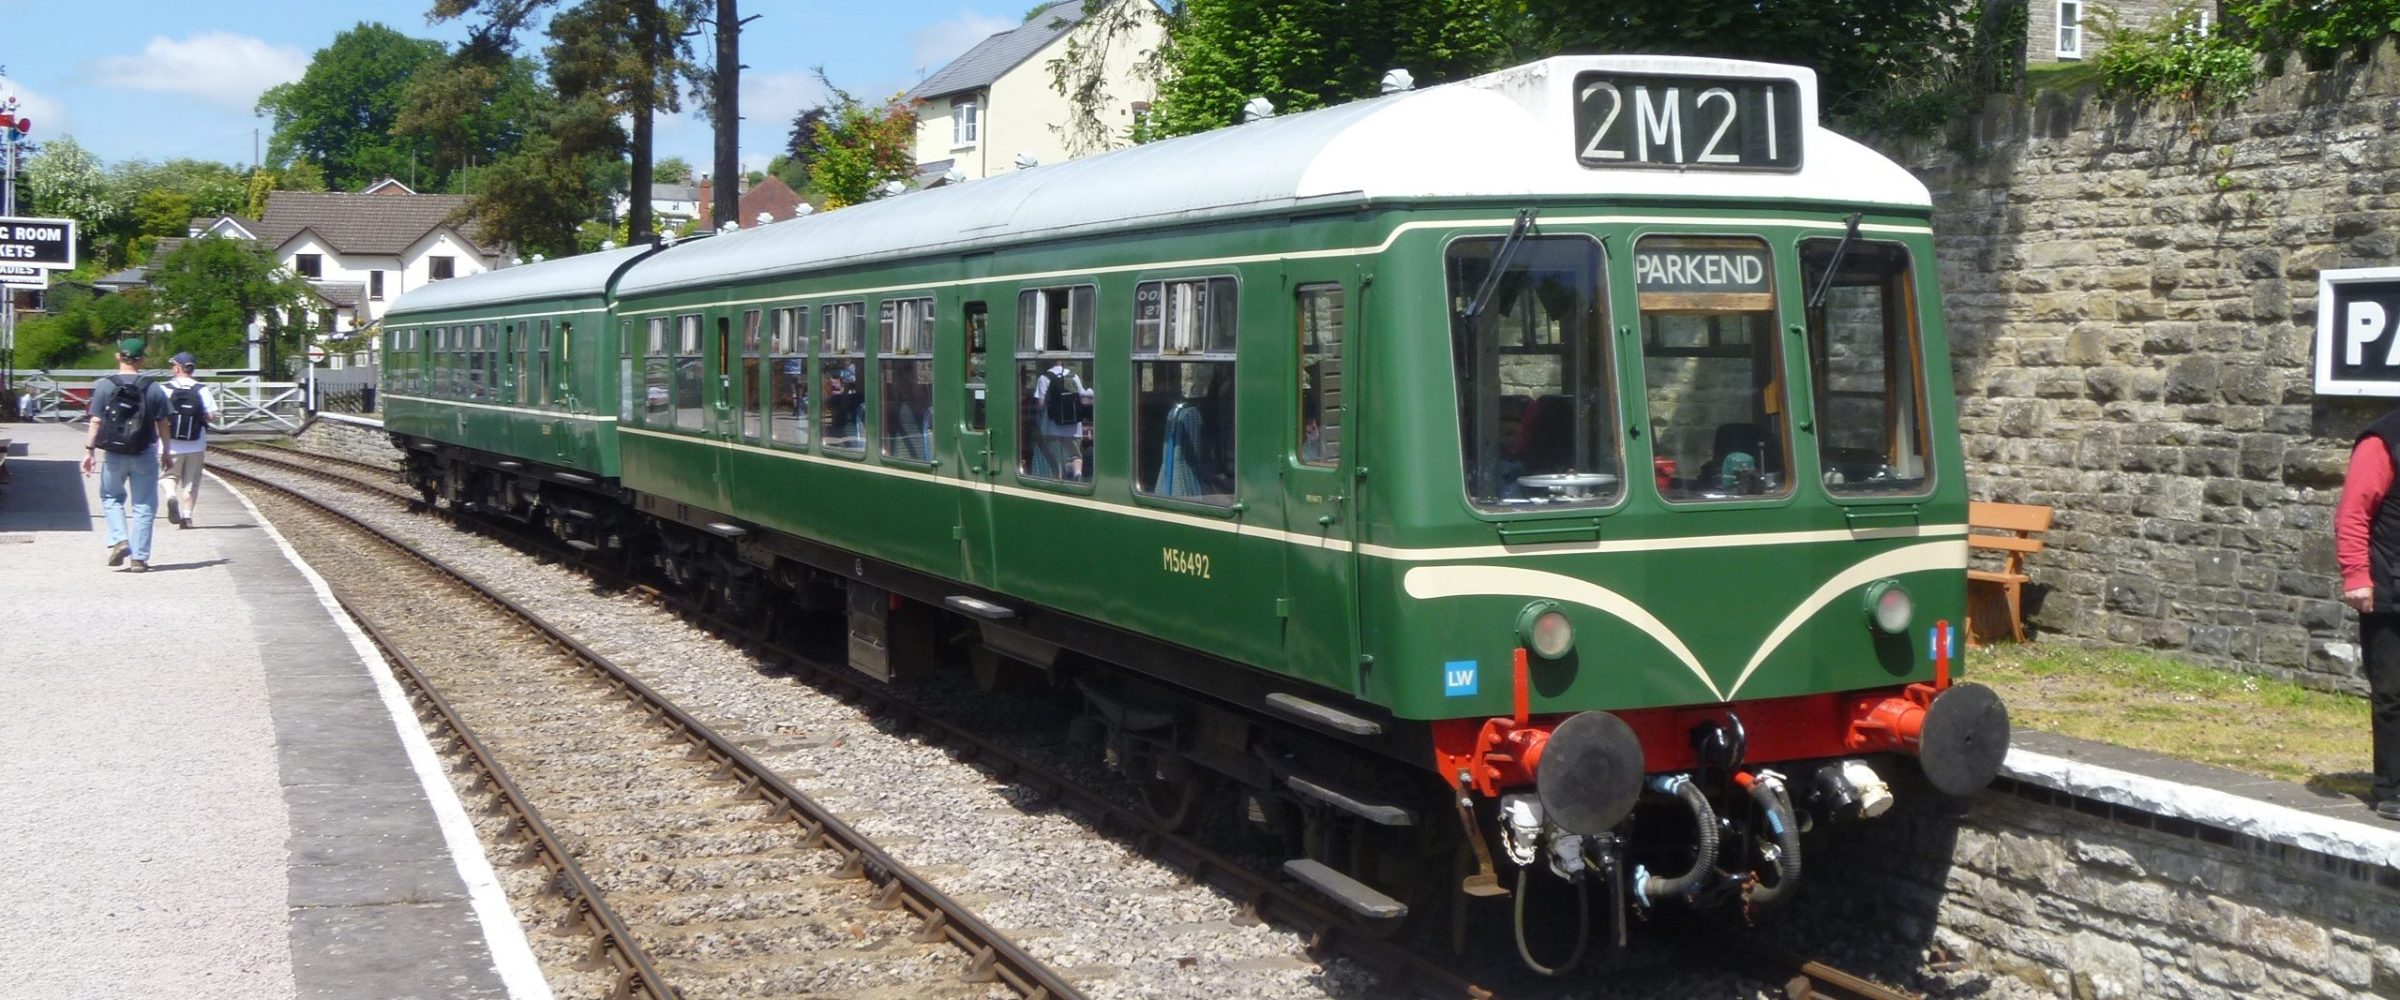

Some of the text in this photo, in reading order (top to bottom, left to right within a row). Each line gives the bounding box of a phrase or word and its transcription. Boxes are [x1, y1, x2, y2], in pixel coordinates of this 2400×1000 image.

[15, 227, 61, 241] ROOM
[1636, 254, 1764, 285] PARKEND
[2346, 301, 2400, 366] P
[1162, 547, 1211, 579] M56492
[1448, 670, 1474, 687] LW
